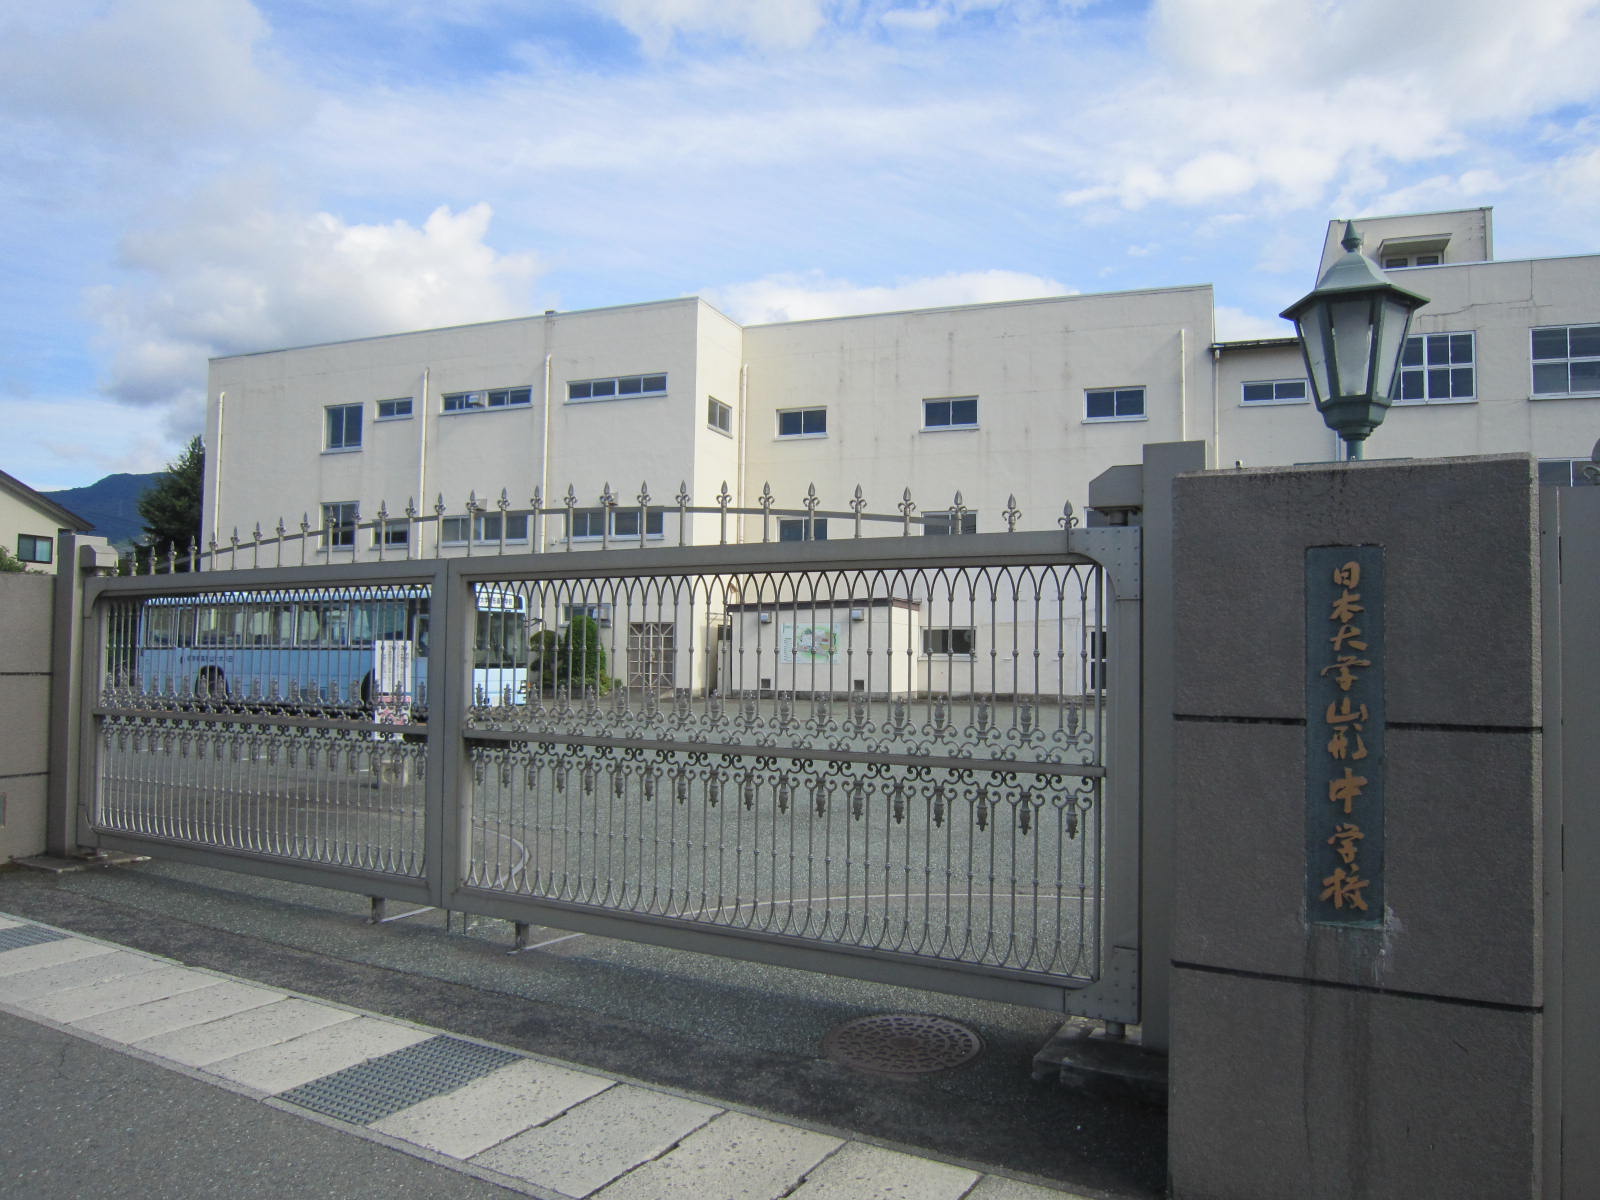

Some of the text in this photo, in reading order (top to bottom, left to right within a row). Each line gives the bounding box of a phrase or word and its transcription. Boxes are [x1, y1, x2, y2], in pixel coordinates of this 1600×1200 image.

[1320, 561, 1370, 911] 日本大学山形中学校
